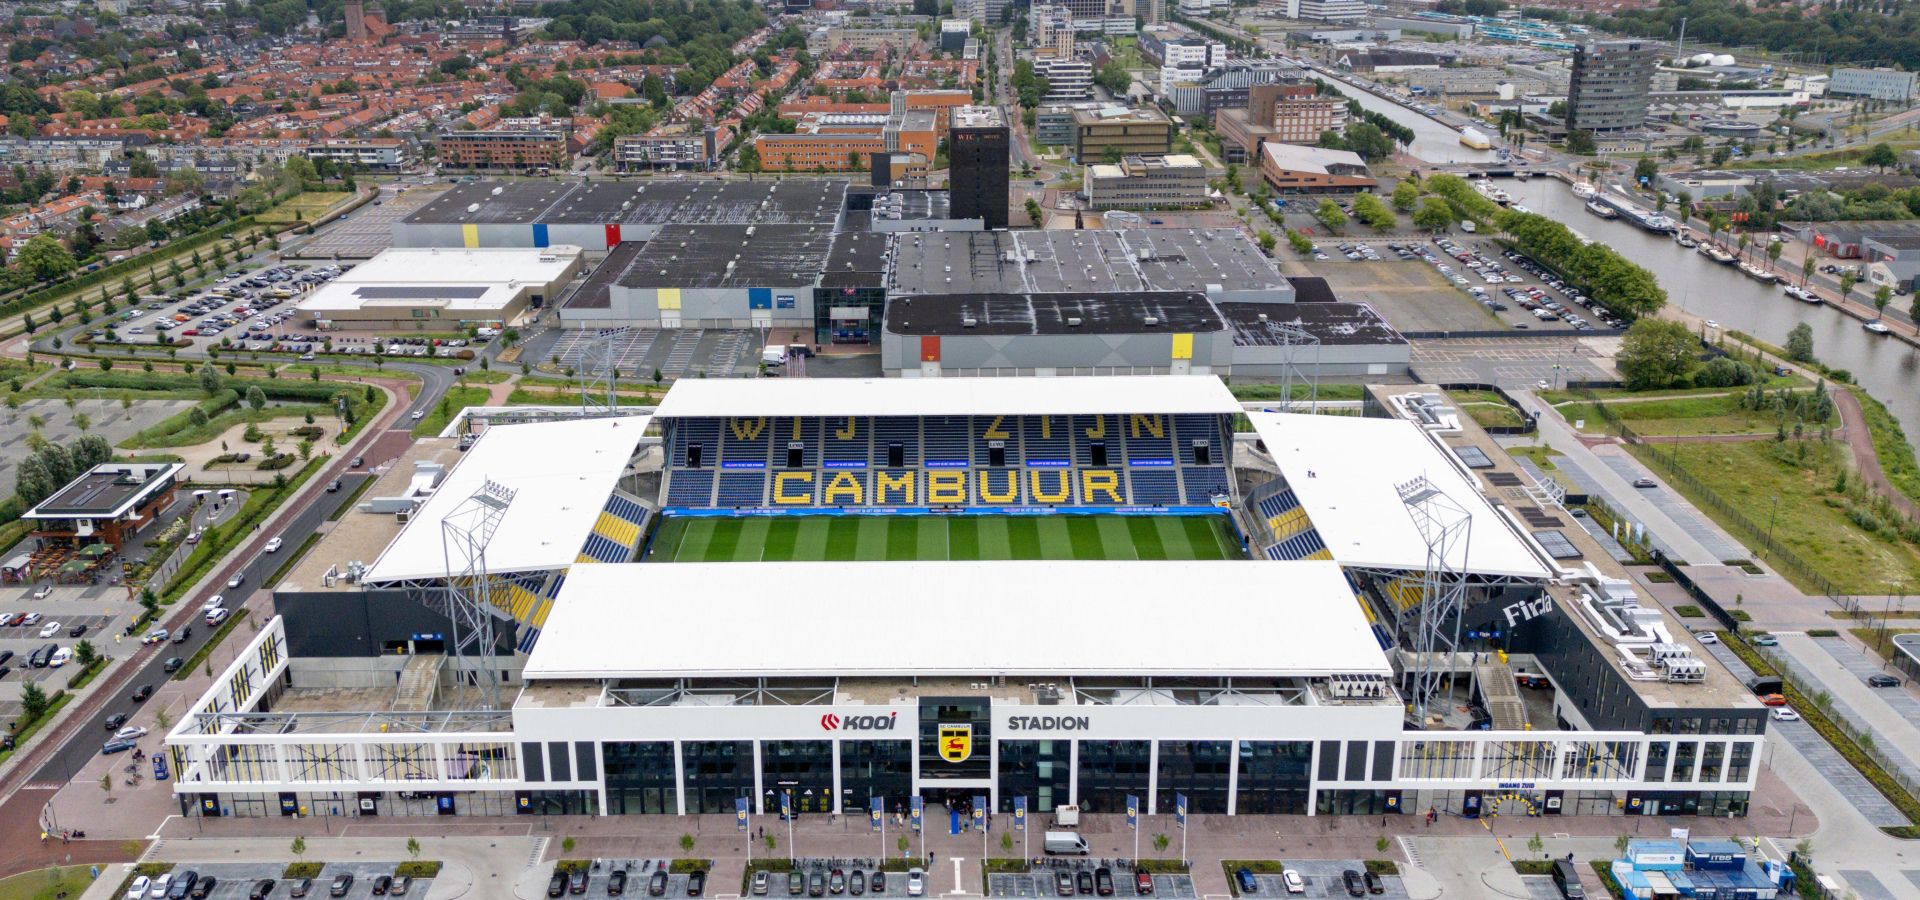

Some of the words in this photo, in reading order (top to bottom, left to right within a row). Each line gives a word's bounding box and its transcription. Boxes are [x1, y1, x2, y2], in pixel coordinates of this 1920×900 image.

[773, 470, 1123, 504] CAMBUUR
[1502, 589, 1553, 628] Firda
[1008, 716, 1089, 730] STADION
